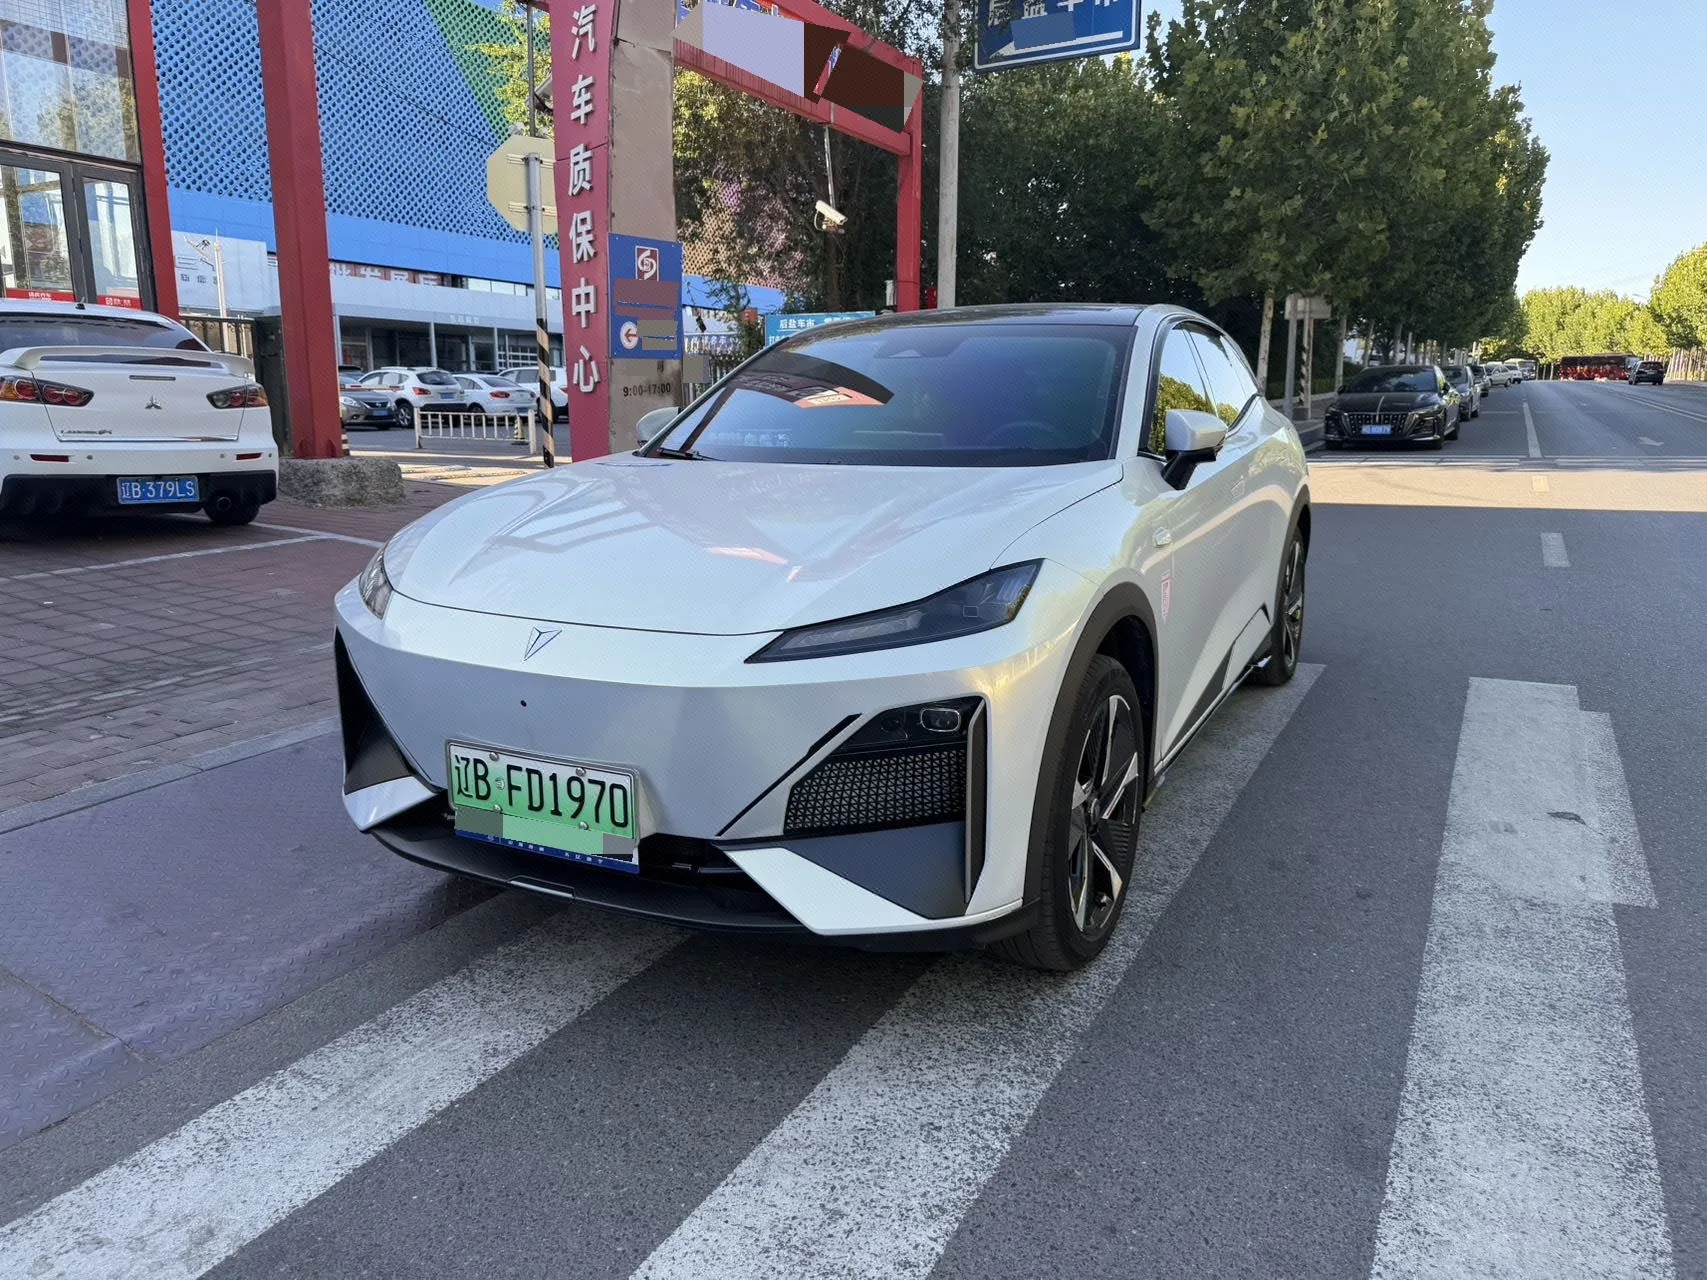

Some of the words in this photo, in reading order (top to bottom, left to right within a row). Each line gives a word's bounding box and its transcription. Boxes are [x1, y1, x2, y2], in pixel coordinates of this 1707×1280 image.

[569, 4, 600, 393] 汽车质保中心
[623, 382, 671, 397] 9:00-17:00
